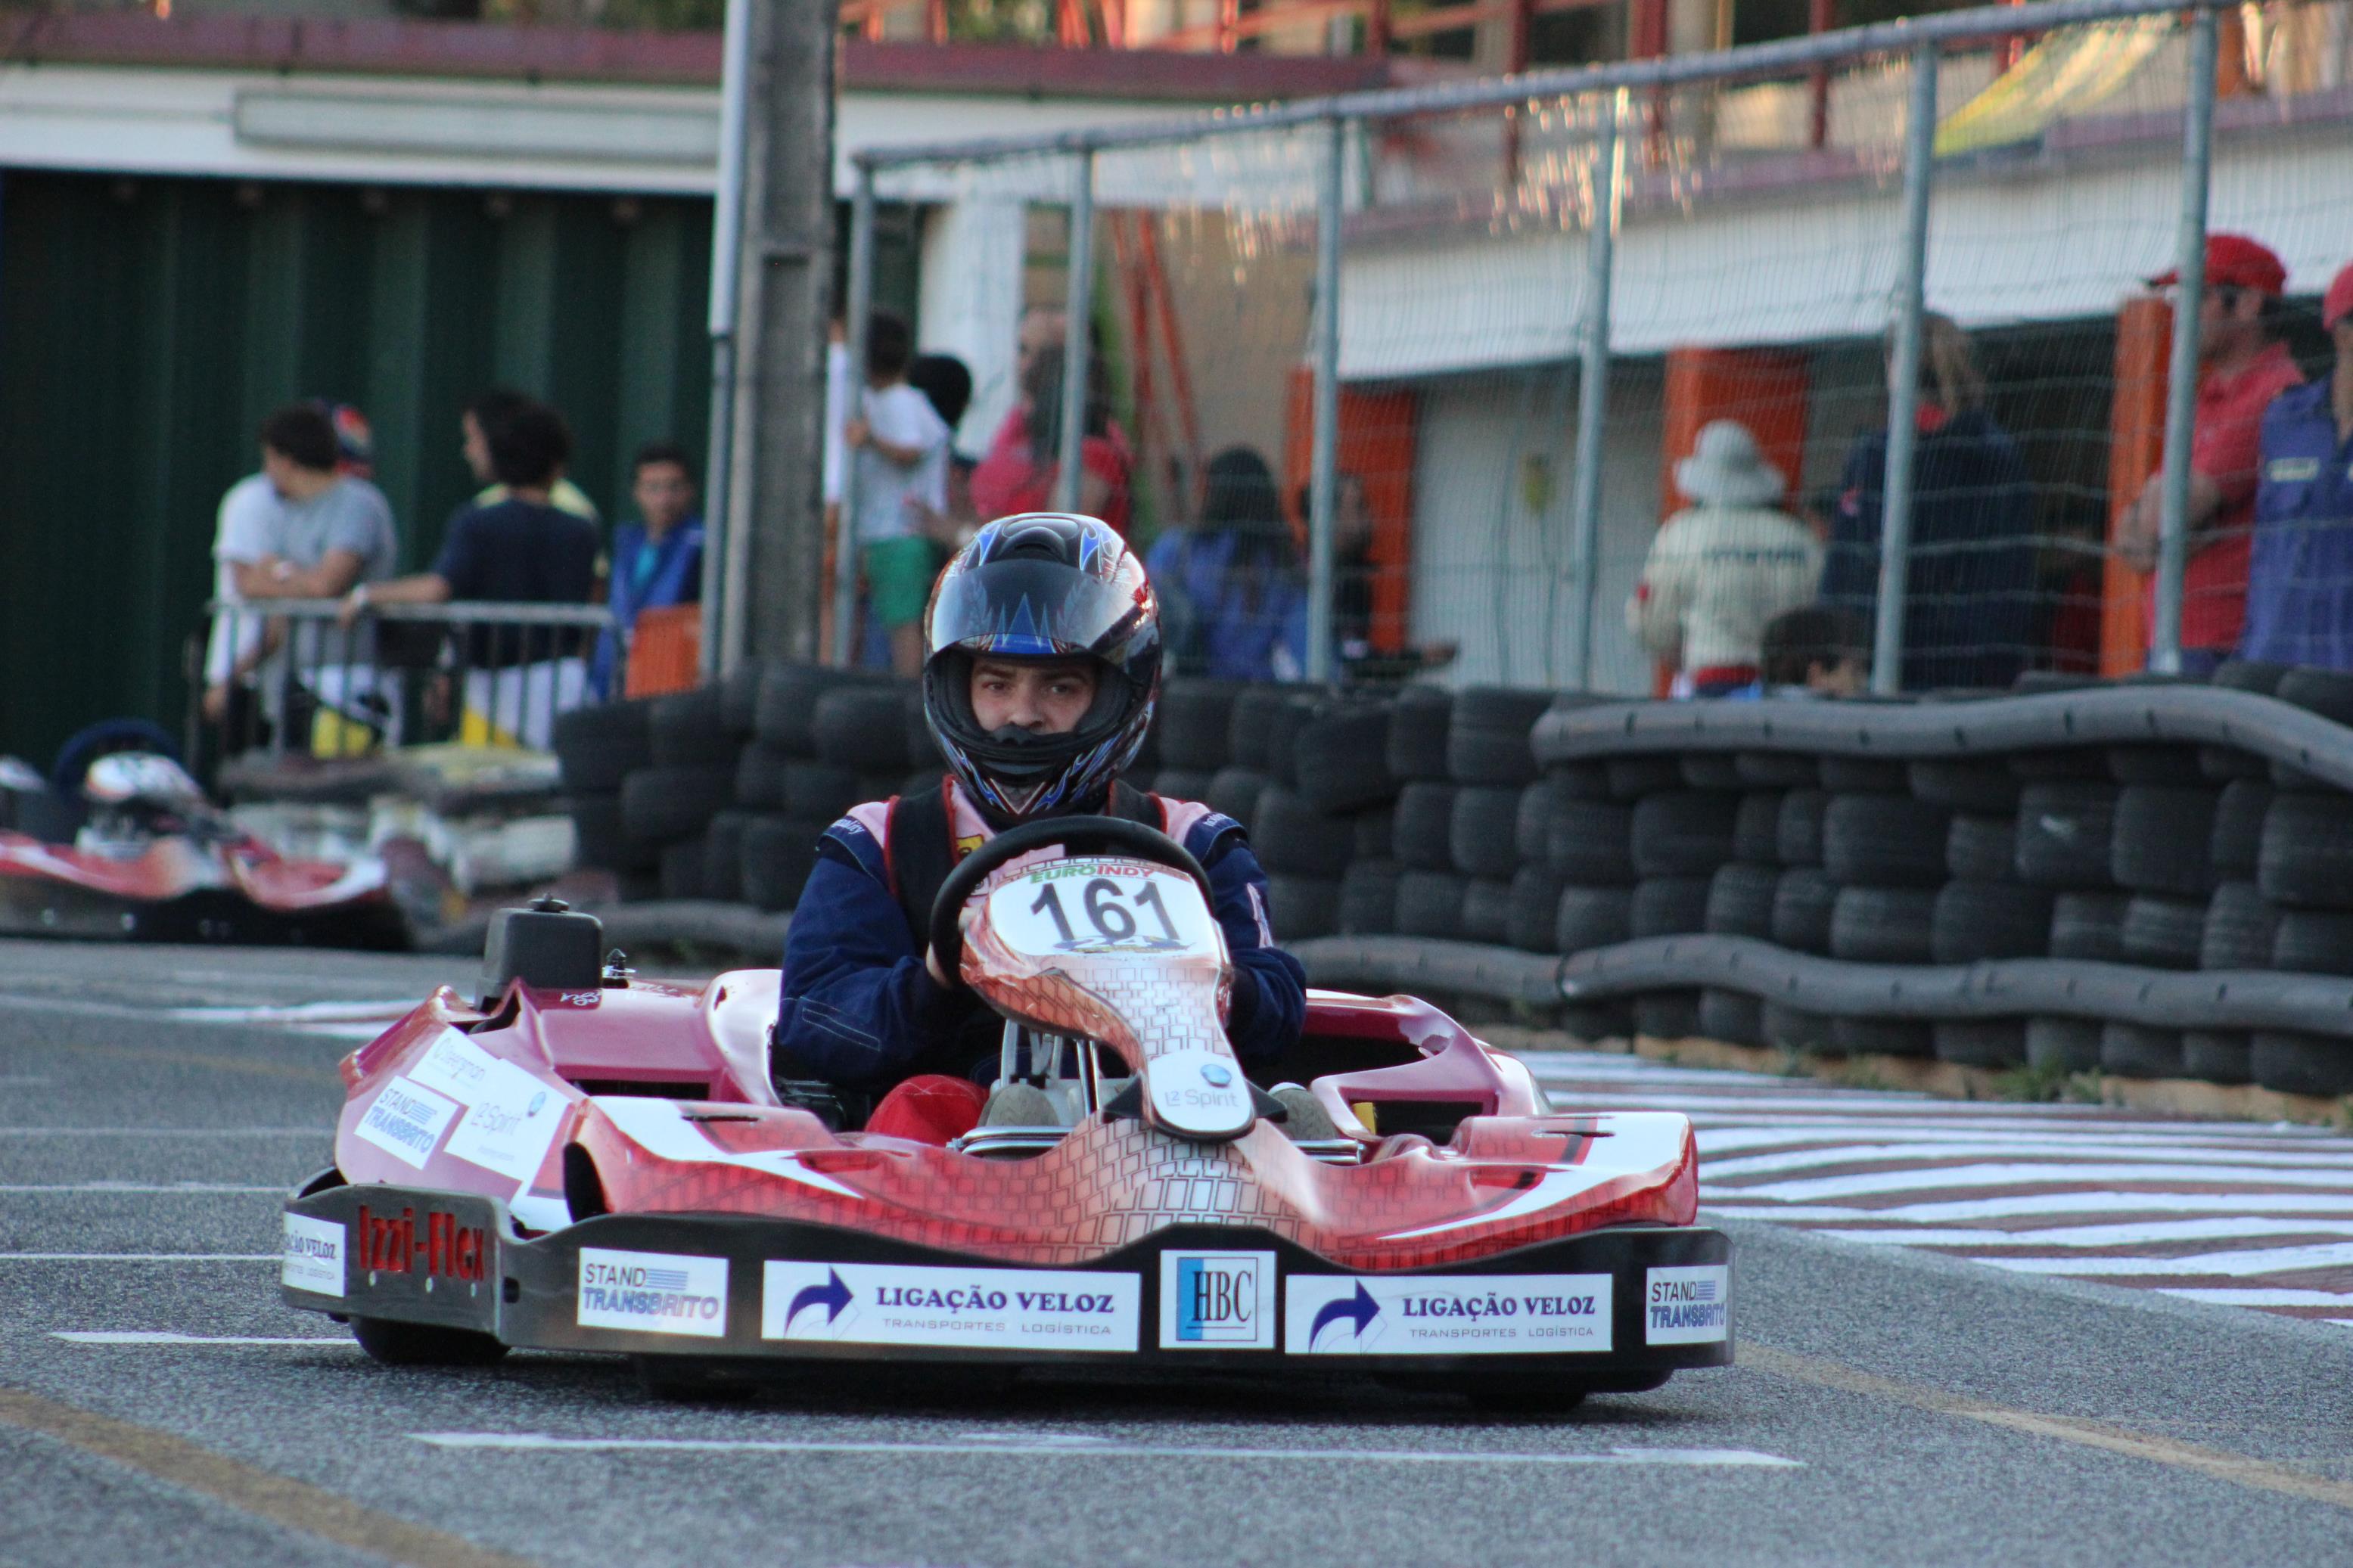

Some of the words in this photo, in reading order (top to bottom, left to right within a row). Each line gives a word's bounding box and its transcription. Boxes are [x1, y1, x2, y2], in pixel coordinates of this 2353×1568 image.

[1030, 878, 1180, 942] 161
[379, 1088, 417, 1115] STAND
[1184, 1088, 1239, 1108] Spirit
[365, 1105, 436, 1153] TRANSBRITO
[306, 1237, 336, 1259] VELOZ
[359, 1205, 484, 1281] Izzi-Flex
[585, 1263, 648, 1287] STAND
[583, 1287, 720, 1319] TRANSBRITO
[876, 1284, 1008, 1314] LIGAÇÃO
[1015, 1291, 1114, 1313] VELOZ
[1192, 1270, 1251, 1322] HBC
[1651, 1281, 1697, 1303] STAND
[1402, 1292, 1517, 1321] LIGAÇÃO
[1524, 1296, 1596, 1315] VELOZ
[1650, 1303, 1725, 1329] TRANSBRITO
[883, 1318, 1006, 1332] TRANSPORTES
[1021, 1321, 1111, 1335] LOGÍSTICA
[1410, 1328, 1517, 1338] TRANSPORTES
[1528, 1325, 1594, 1337] LOGÍSTICA
